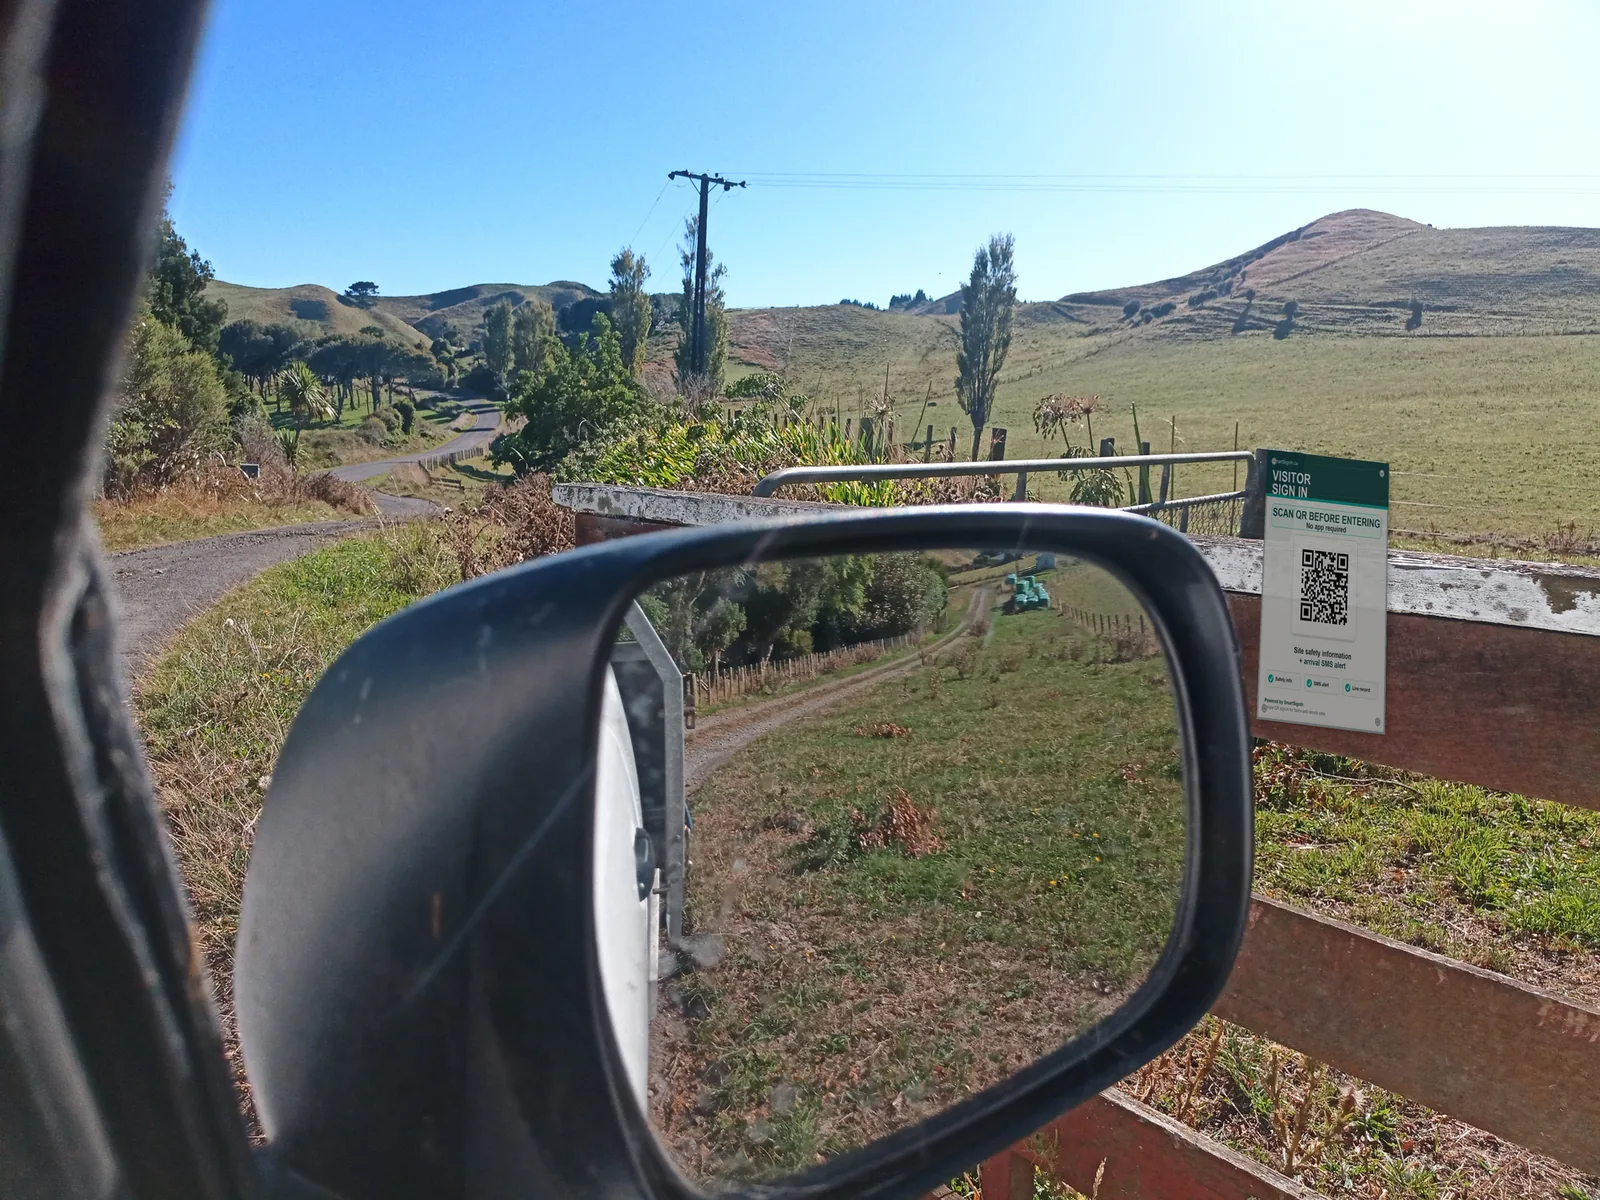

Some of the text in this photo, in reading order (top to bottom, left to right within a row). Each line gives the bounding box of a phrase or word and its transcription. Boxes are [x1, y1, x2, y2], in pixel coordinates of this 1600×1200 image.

[1272, 470, 1311, 485] VISITOR
[1272, 483, 1308, 498] SIGN IN
[1272, 507, 1381, 528] SCAN QR BEFORE ENTERING
[1325, 524, 1347, 533] required
[1294, 646, 1352, 660] Site safety information
[1304, 658, 1320, 666] arrival
[1321, 660, 1333, 668] SMS
[1334, 661, 1346, 669] alert
